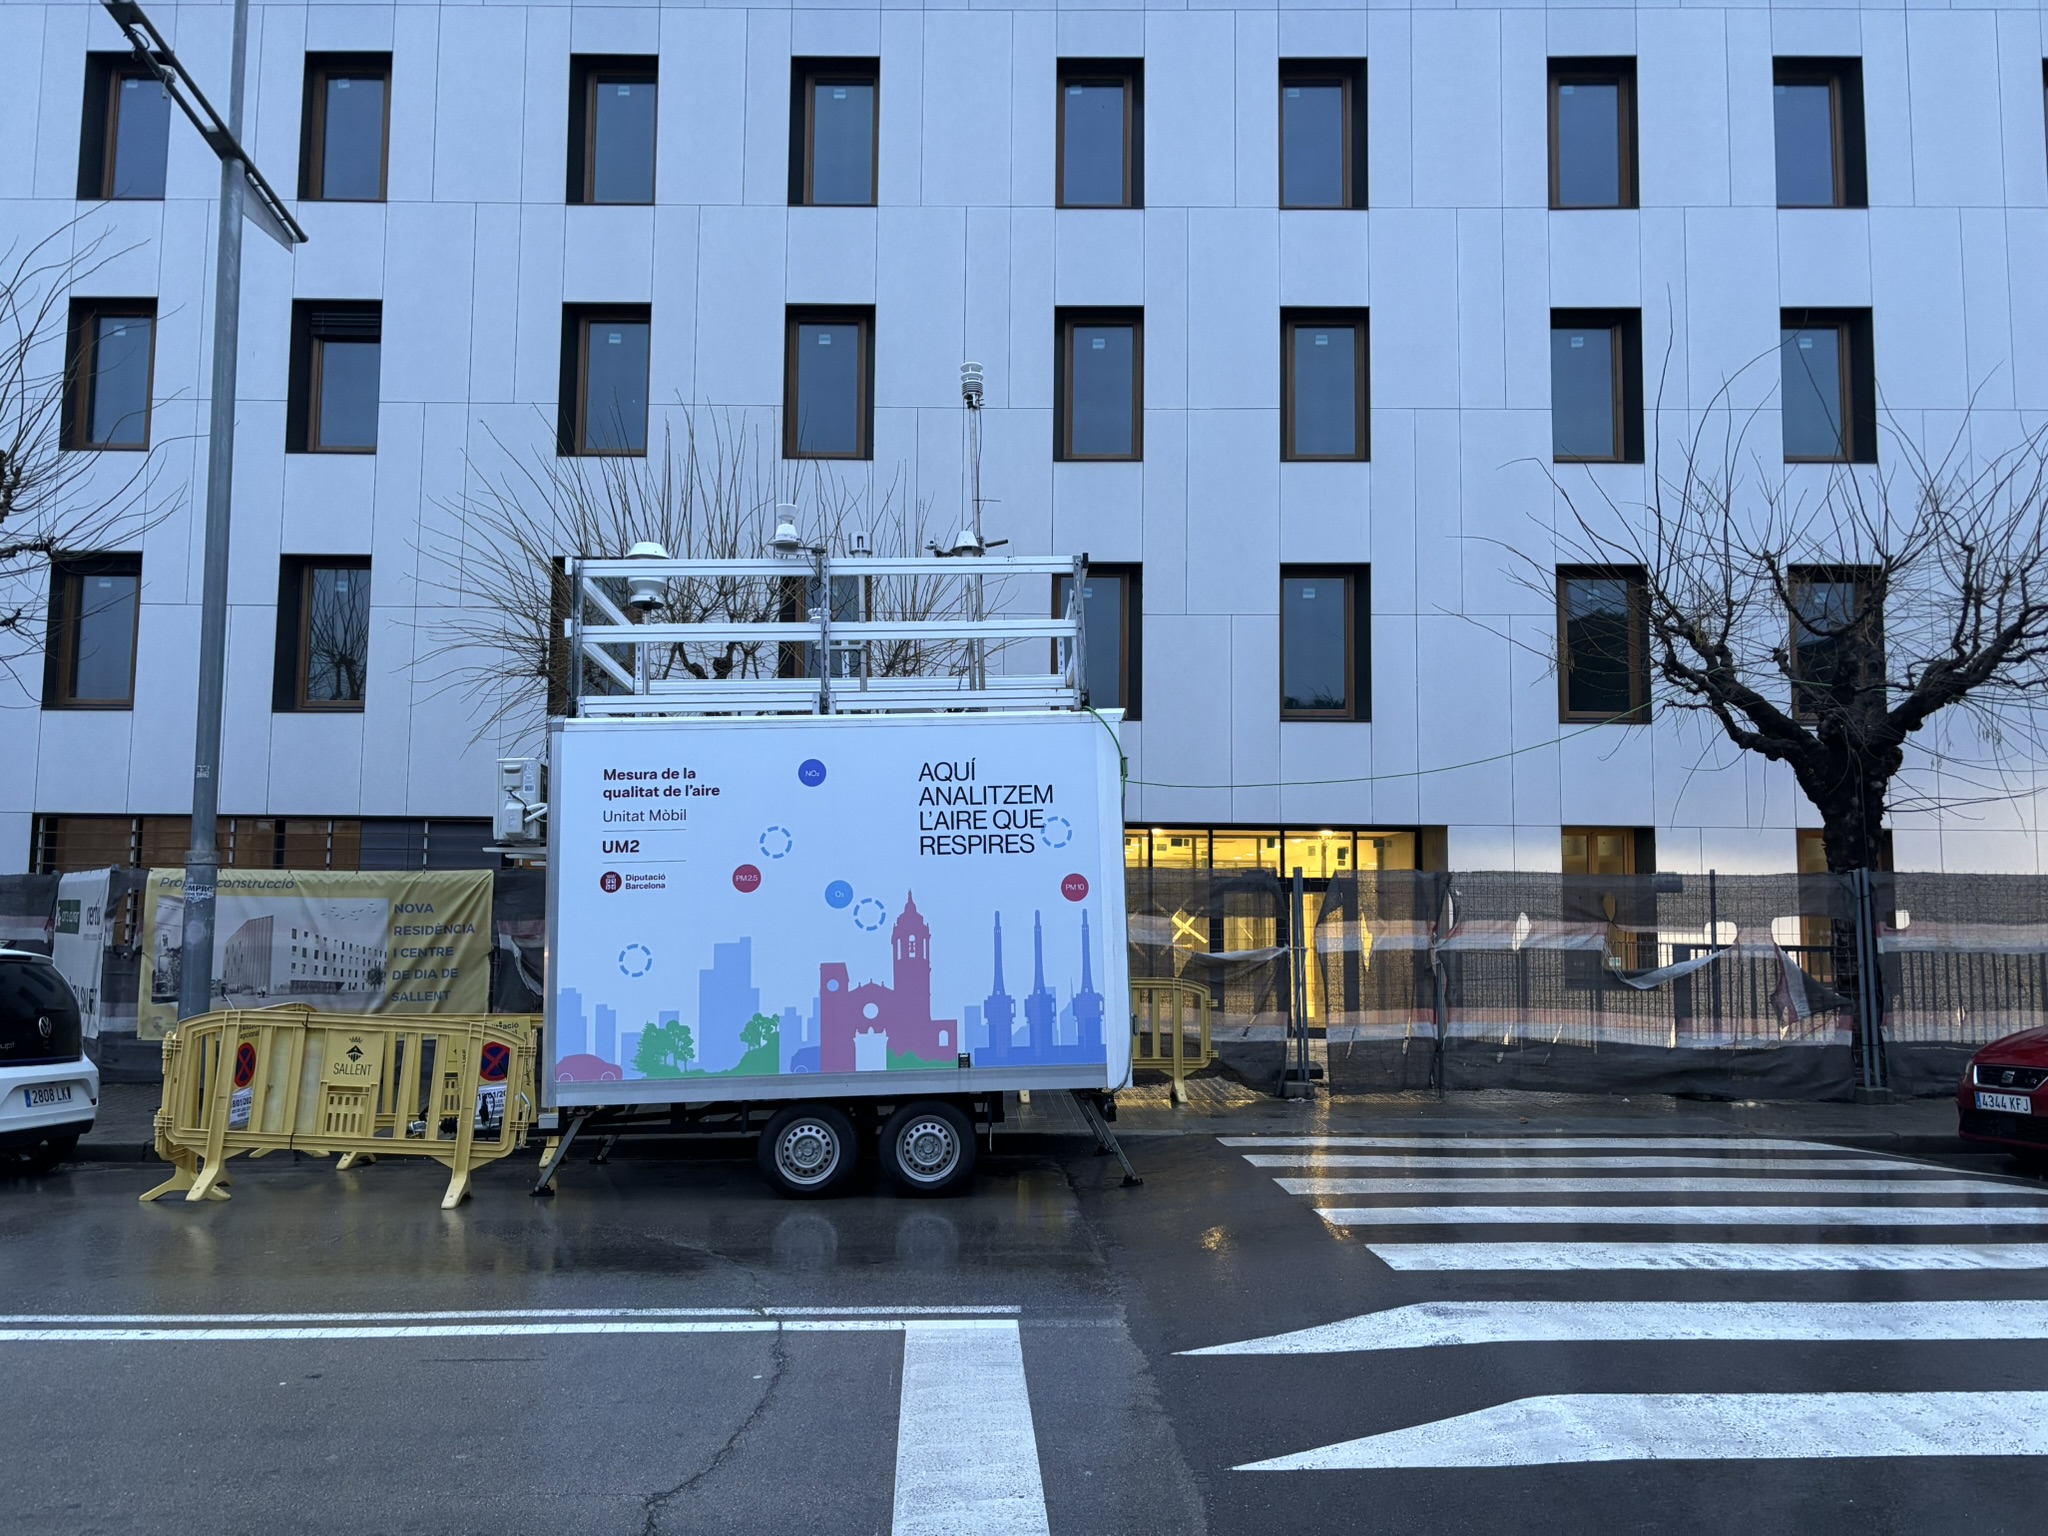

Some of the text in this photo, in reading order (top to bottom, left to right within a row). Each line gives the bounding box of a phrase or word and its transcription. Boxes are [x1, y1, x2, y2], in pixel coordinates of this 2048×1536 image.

[603, 767, 696, 780] Mesura de la
[918, 757, 976, 782] AQUÍ
[603, 786, 660, 801] qualitat
[663, 785, 682, 797] de
[918, 784, 1054, 806] ANALITZEM
[603, 809, 687, 822] Unitat Mòbil
[992, 809, 1045, 830] QUE
[602, 840, 640, 853] UM2
[920, 833, 1035, 855] RESPIRES
[217, 877, 295, 889] construcció
[625, 873, 666, 882] Diputació
[625, 882, 666, 890] Barcelona
[394, 903, 434, 914] NOVA
[393, 922, 475, 936] RESIDÈNCIA
[393, 946, 454, 958] I CENTRE
[392, 967, 459, 980] DE DIA DE
[391, 990, 451, 1002] SALLENT
[333, 1062, 373, 1076] SALLENT
[32, 1087, 55, 1104] 2808
[1982, 1094, 2029, 1112] 4344 KFJ
